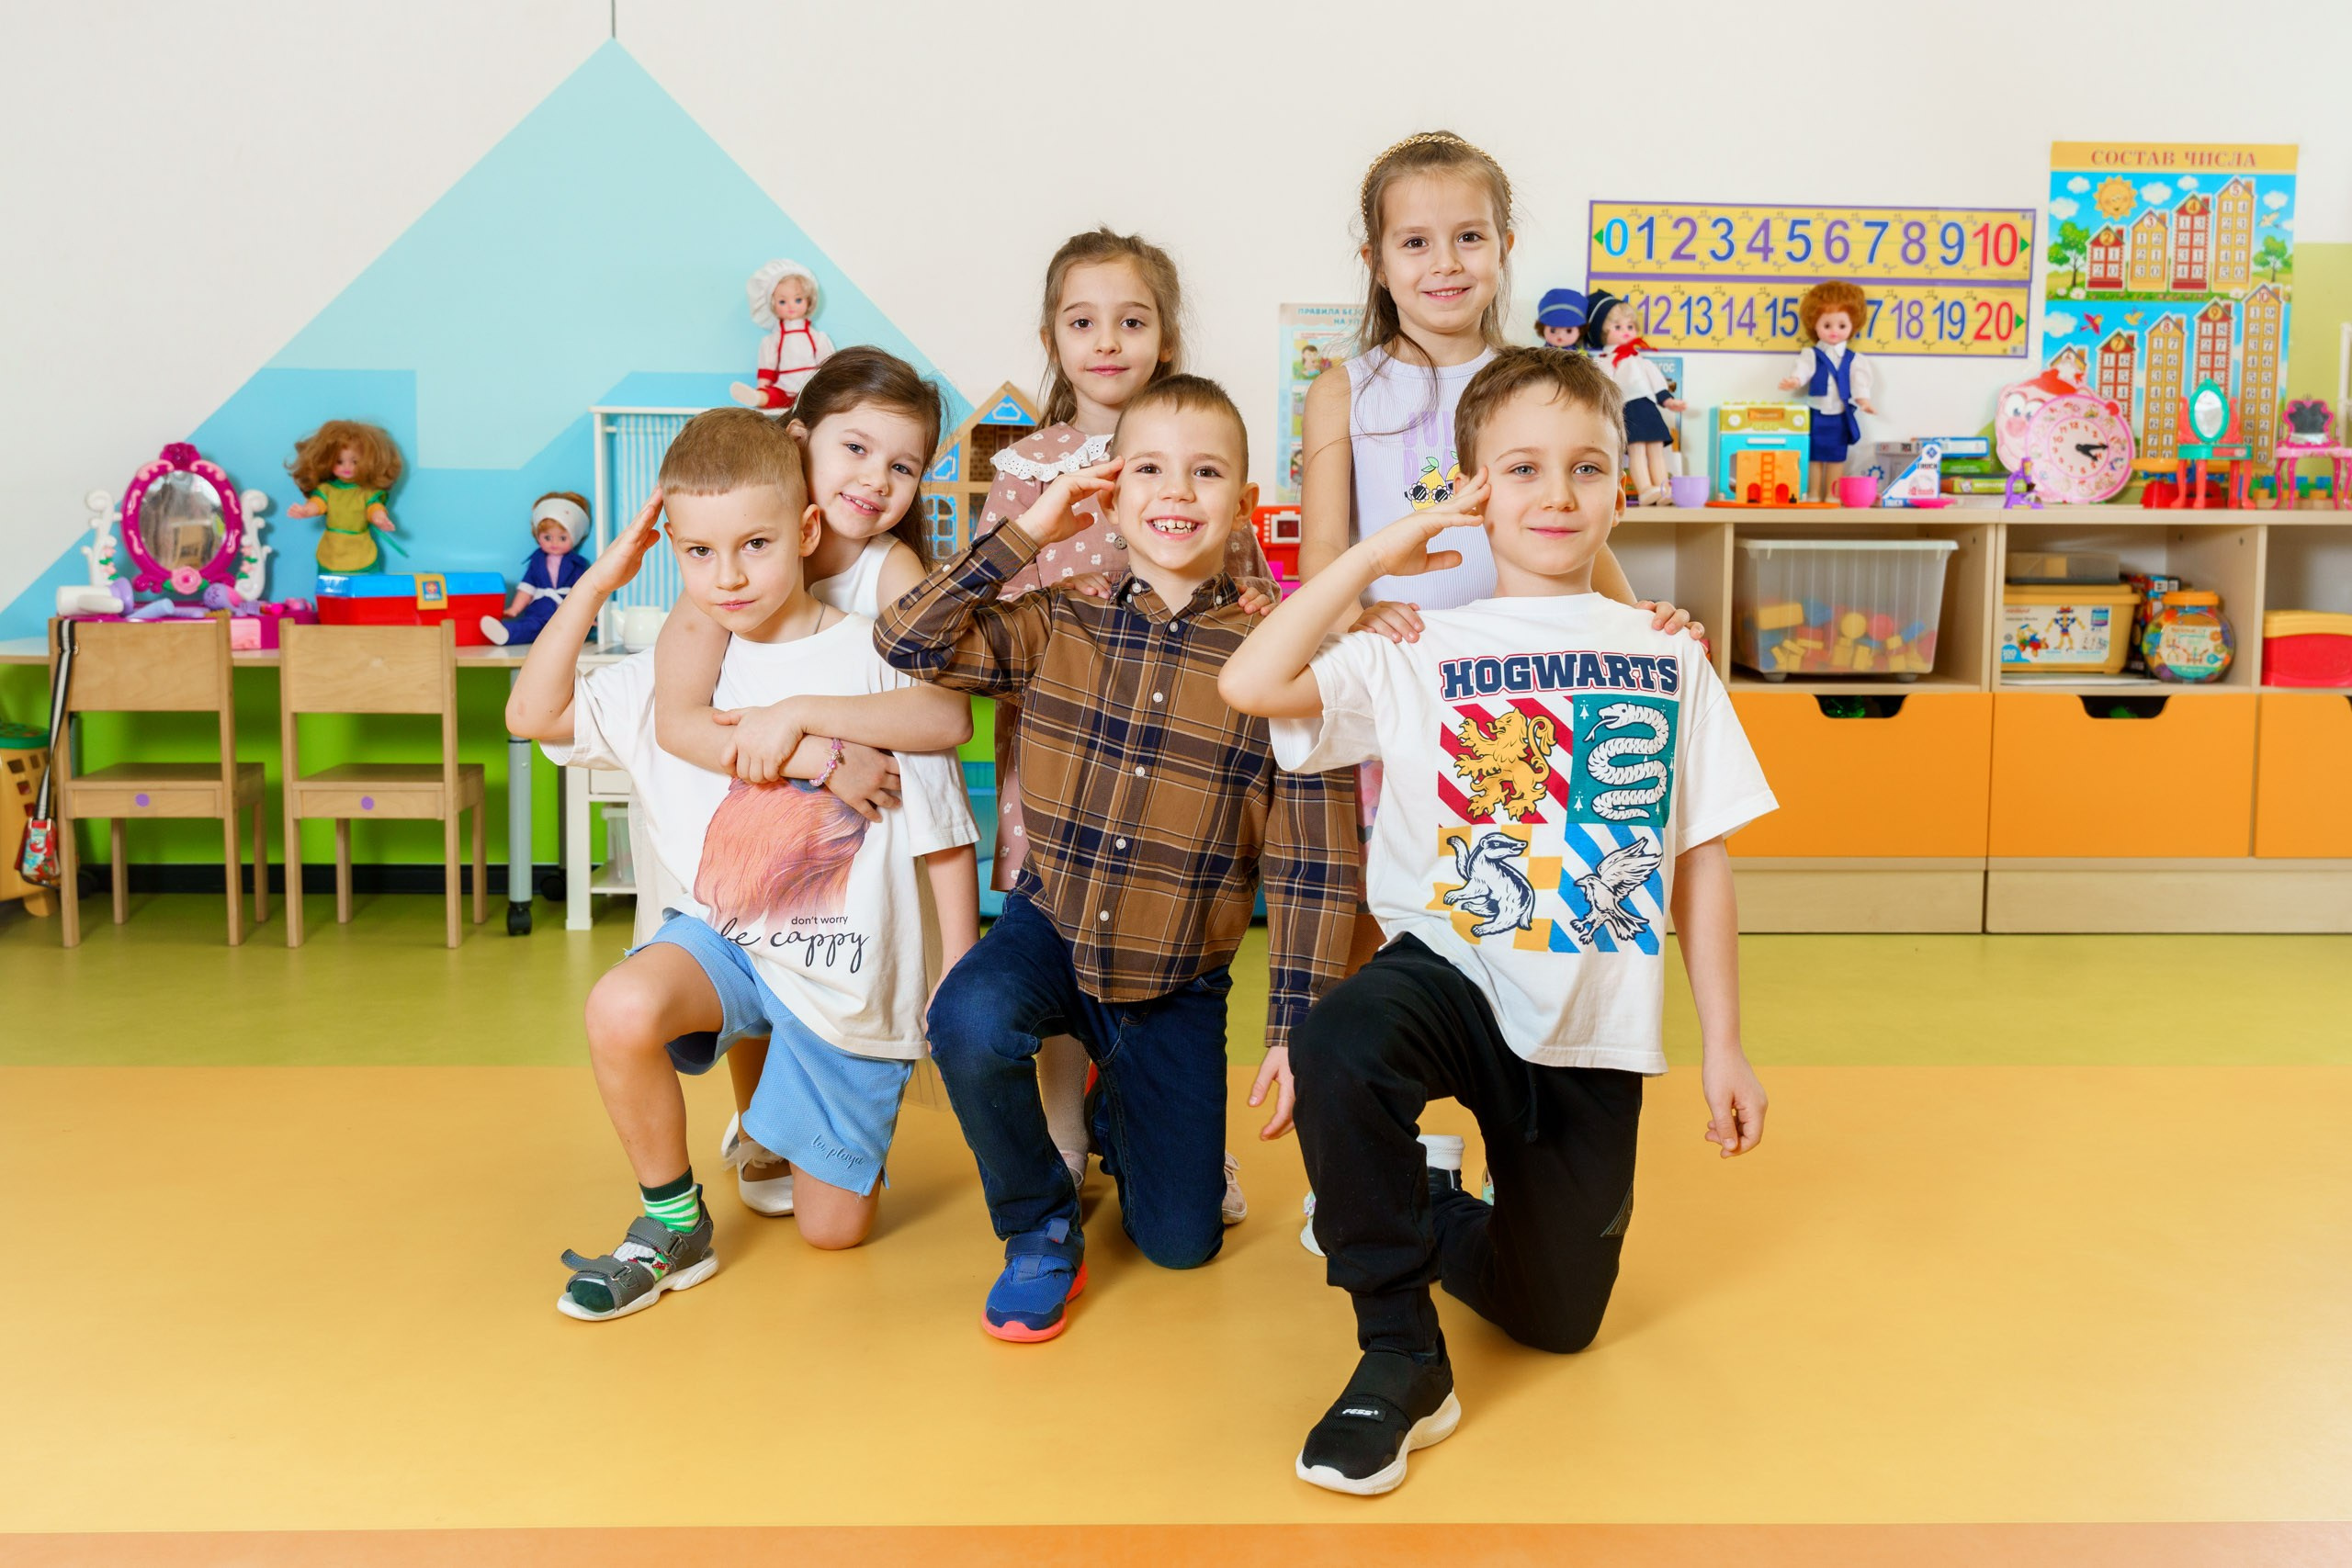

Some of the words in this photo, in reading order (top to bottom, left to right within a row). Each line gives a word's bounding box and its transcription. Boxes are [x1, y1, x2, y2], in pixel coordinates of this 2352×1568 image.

[2091, 151, 2175, 166] СОСТАВ
[2185, 151, 2256, 167] ЧИСЛА
[2232, 185, 2240, 196] 5
[2188, 201, 2197, 212] 4
[2146, 216, 2154, 227] 3
[1604, 218, 1628, 256] 0
[1637, 216, 1654, 260] 1
[1670, 217, 1698, 261] 2
[1709, 217, 1735, 262] 3
[1746, 218, 1774, 263] 4
[1786, 219, 1812, 263] 5
[1824, 220, 1850, 264] 6
[1863, 220, 1889, 265] 7
[1900, 220, 1927, 265] 8
[1939, 221, 1965, 266] 9
[1972, 222, 2018, 267] 10
[2103, 231, 2111, 243] 2
[1637, 294, 1672, 335] 12
[1679, 295, 1713, 336] 13
[1720, 296, 1757, 337] 14
[1765, 297, 1799, 338] 15
[1854, 299, 1883, 339] 7
[1890, 299, 1924, 340] 18
[1932, 299, 1966, 341] 19
[1973, 301, 2014, 342] 20
[1440, 650, 1679, 701] HOGWARTS
[791, 916, 818, 926] don't
[820, 916, 849, 926] worry
[720, 917, 762, 946] be
[770, 931, 870, 974] cappy
